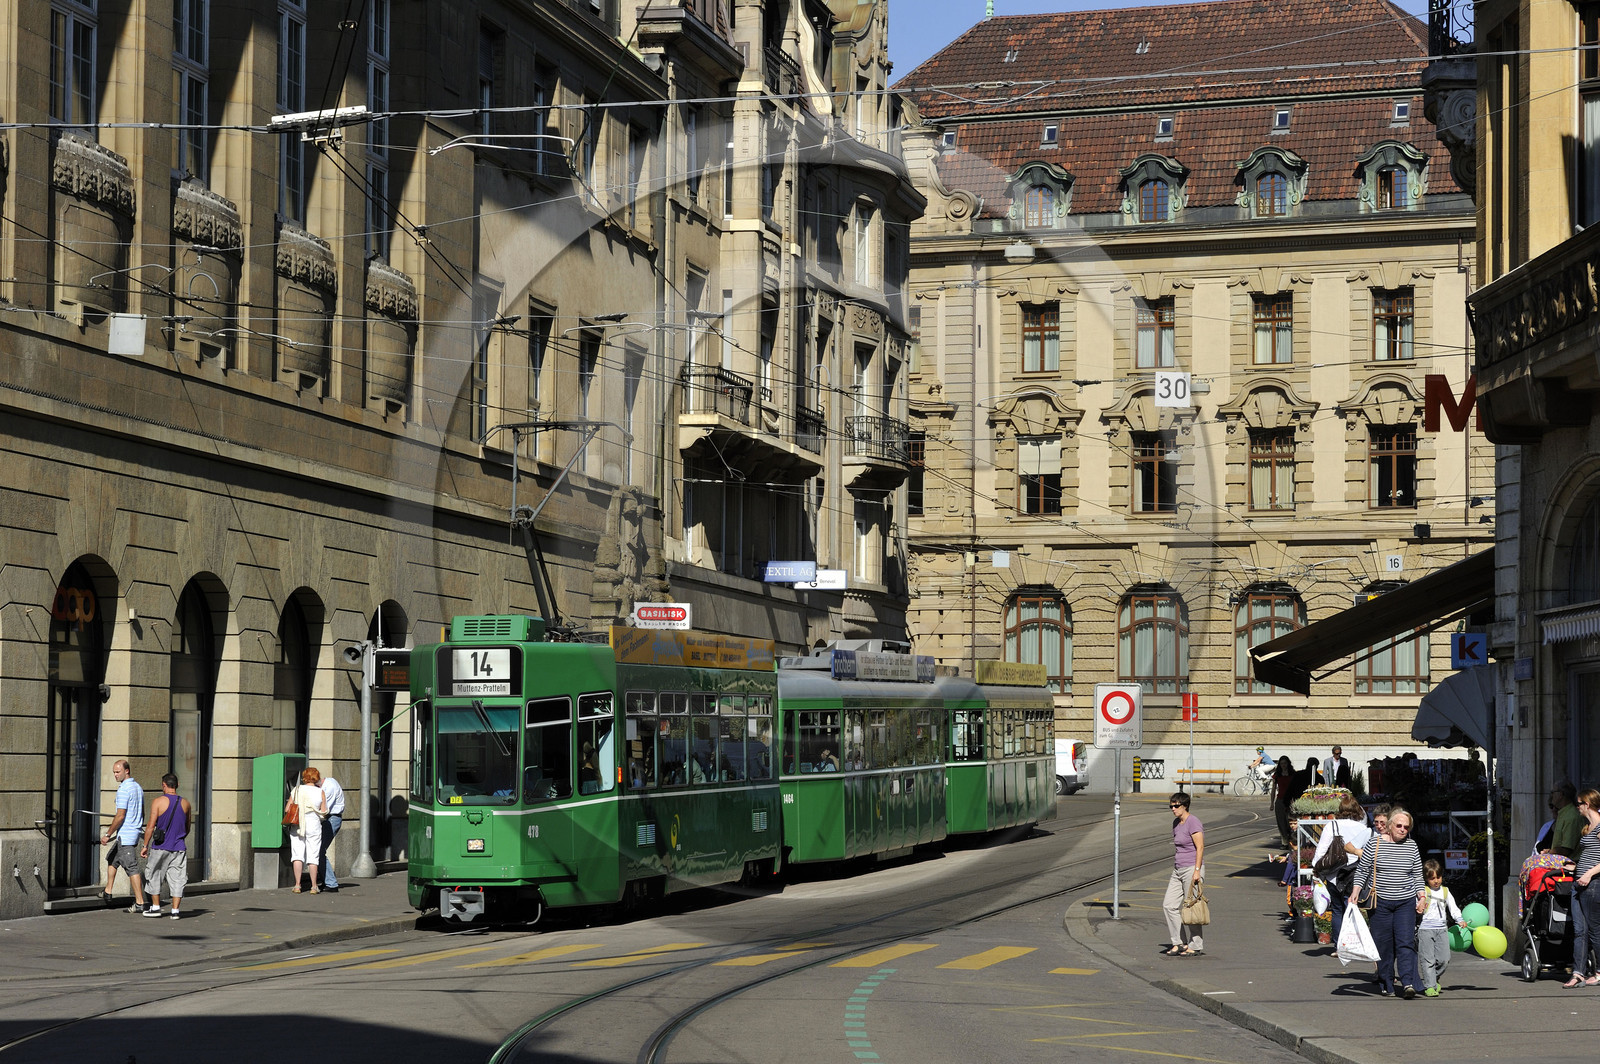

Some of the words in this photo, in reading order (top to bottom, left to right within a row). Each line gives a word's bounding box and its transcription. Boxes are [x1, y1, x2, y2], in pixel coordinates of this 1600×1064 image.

[1159, 377, 1187, 400] 30
[1389, 557, 1400, 569] 16
[761, 566, 797, 577] TEXTIL
[799, 566, 813, 577] AG
[640, 610, 683, 618] BASILISK
[470, 651, 494, 677] 14
[456, 684, 507, 693] Muttenz-Pratteln
[782, 793, 795, 804] 1464
[527, 825, 540, 838] 478
